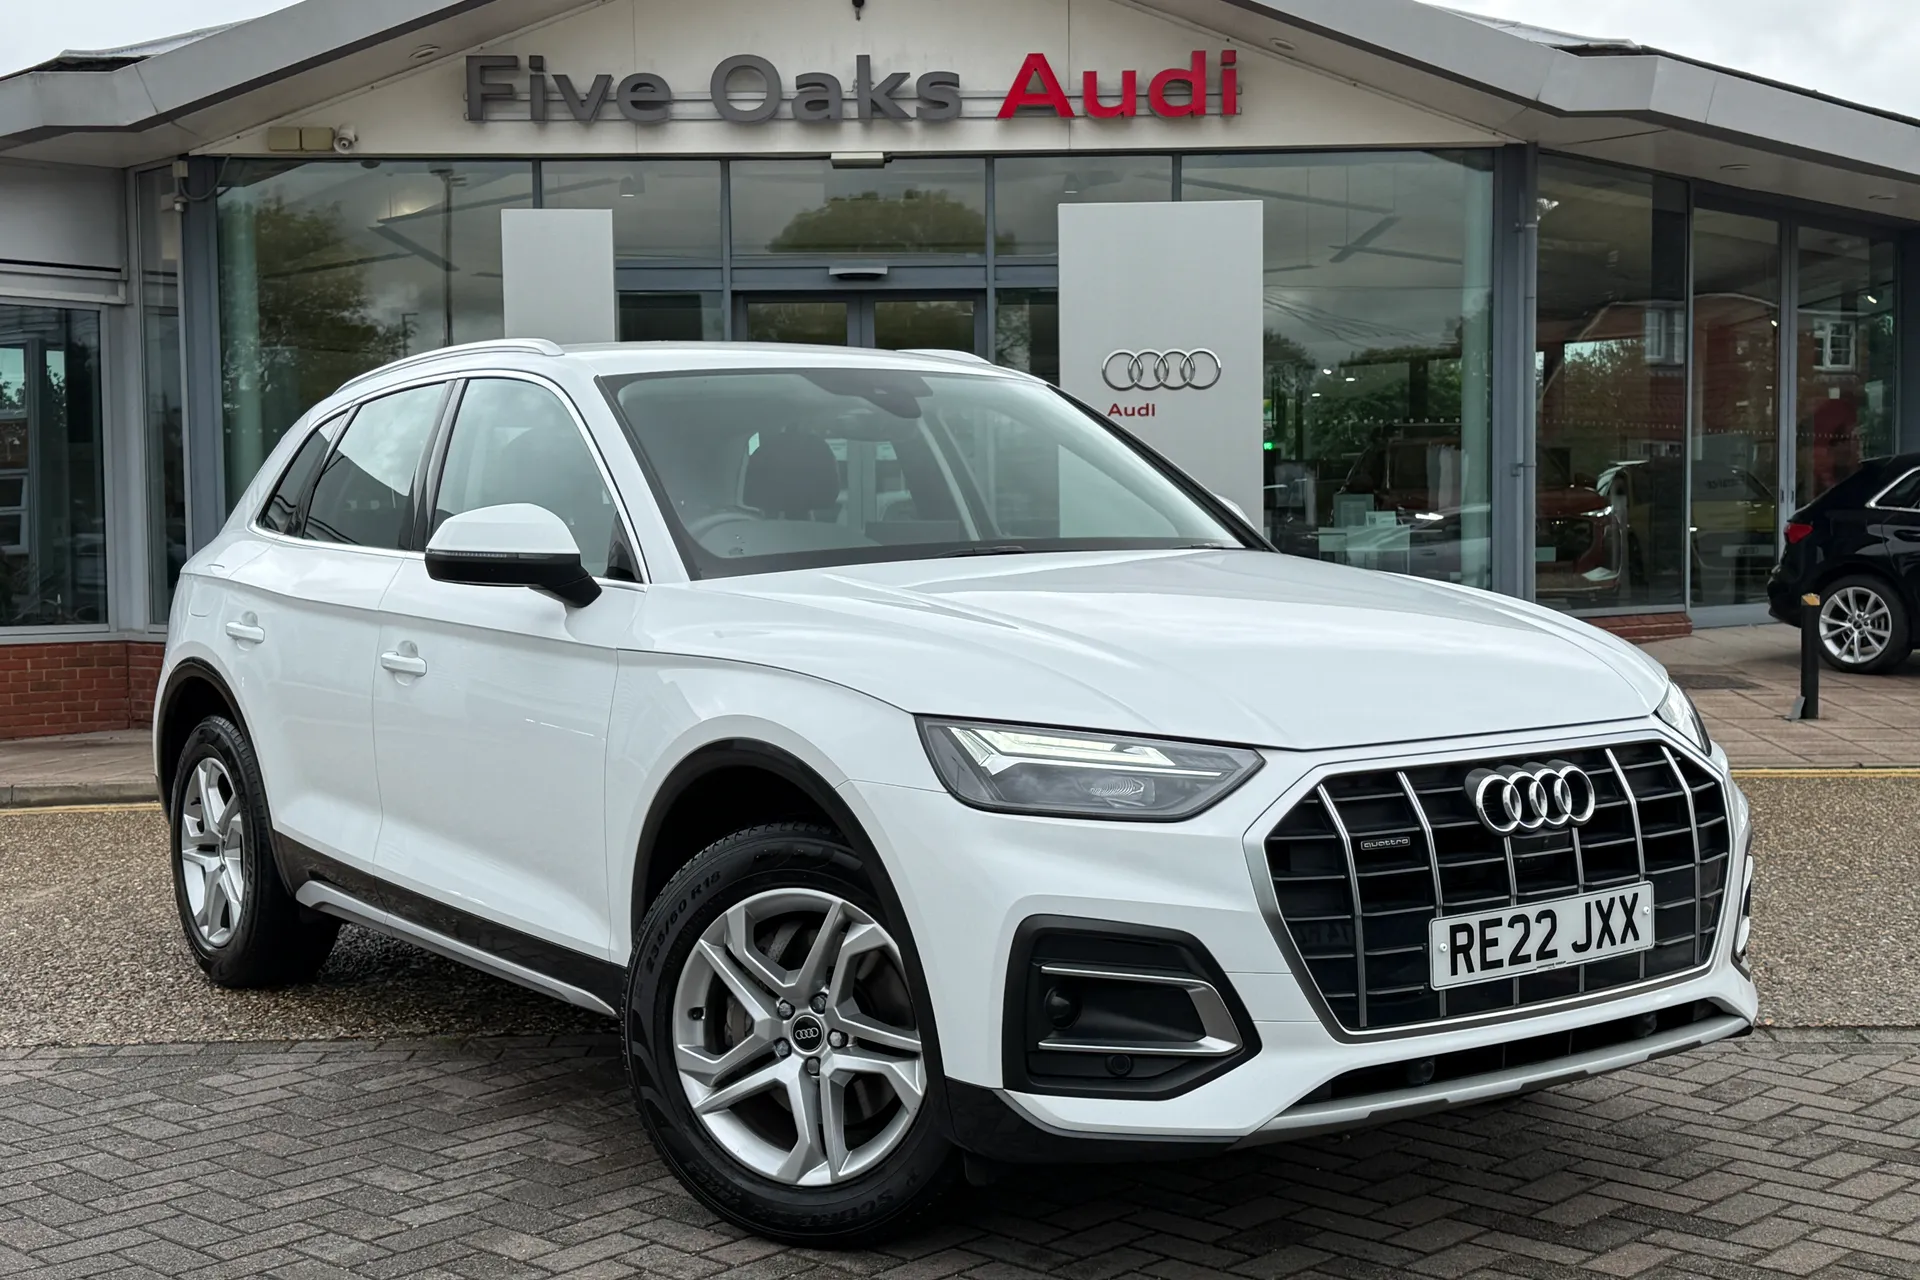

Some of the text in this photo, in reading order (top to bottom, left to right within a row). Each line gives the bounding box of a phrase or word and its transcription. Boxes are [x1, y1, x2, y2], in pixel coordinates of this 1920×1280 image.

[465, 49, 1238, 123] Five Oaks Audi
[1107, 402, 1156, 417] Audi
[1363, 838, 1409, 848] quattro
[1449, 892, 1640, 976] RE22 JXX
